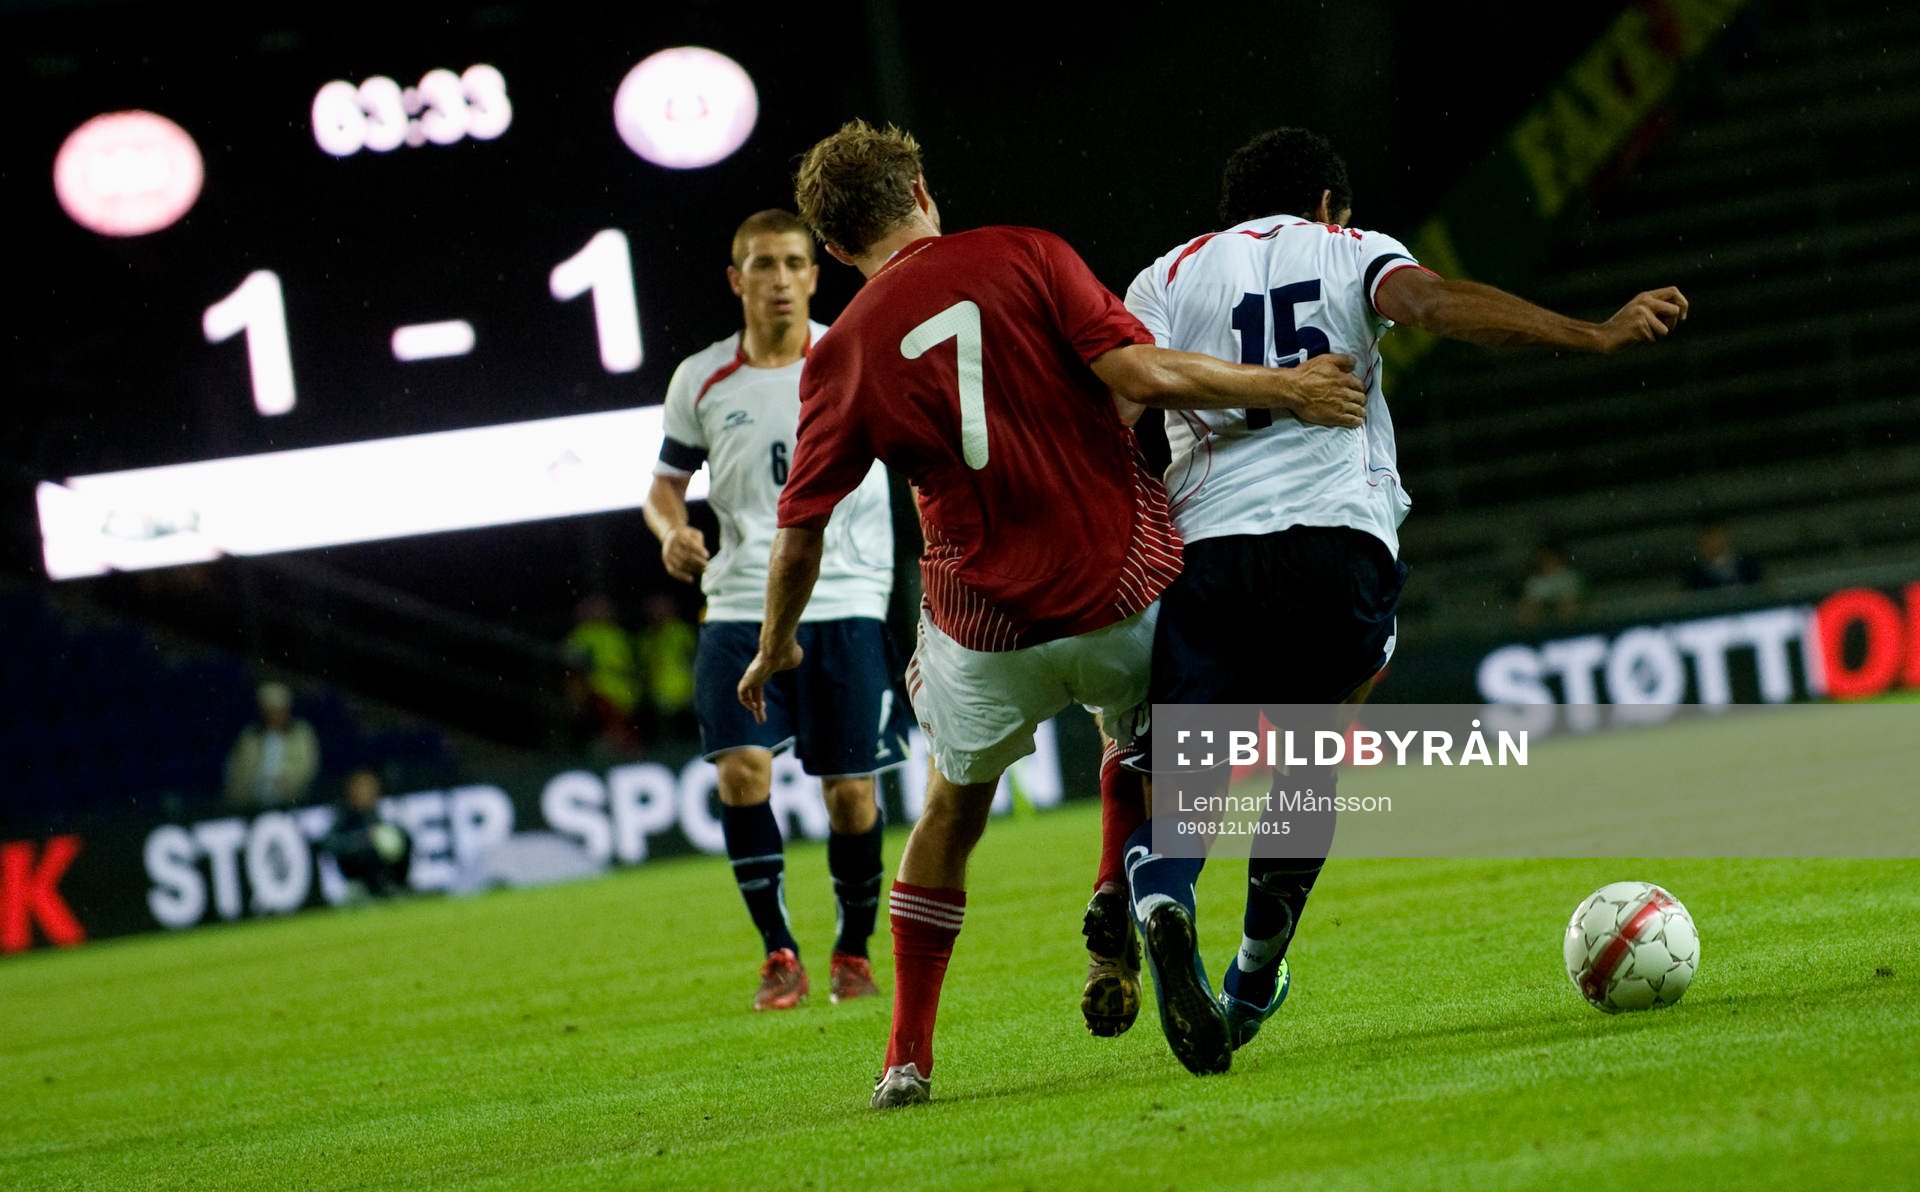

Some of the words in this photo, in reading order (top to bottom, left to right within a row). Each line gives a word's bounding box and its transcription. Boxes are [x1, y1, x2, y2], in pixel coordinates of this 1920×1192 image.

[203, 269, 296, 416] 1
[549, 228, 643, 374] 1
[900, 300, 989, 471] 7
[1231, 278, 1331, 430] 15
[771, 440, 789, 486] 6
[1477, 605, 1826, 742] STØTT
[1816, 580, 1920, 699] O
[144, 784, 515, 929] STØTER
